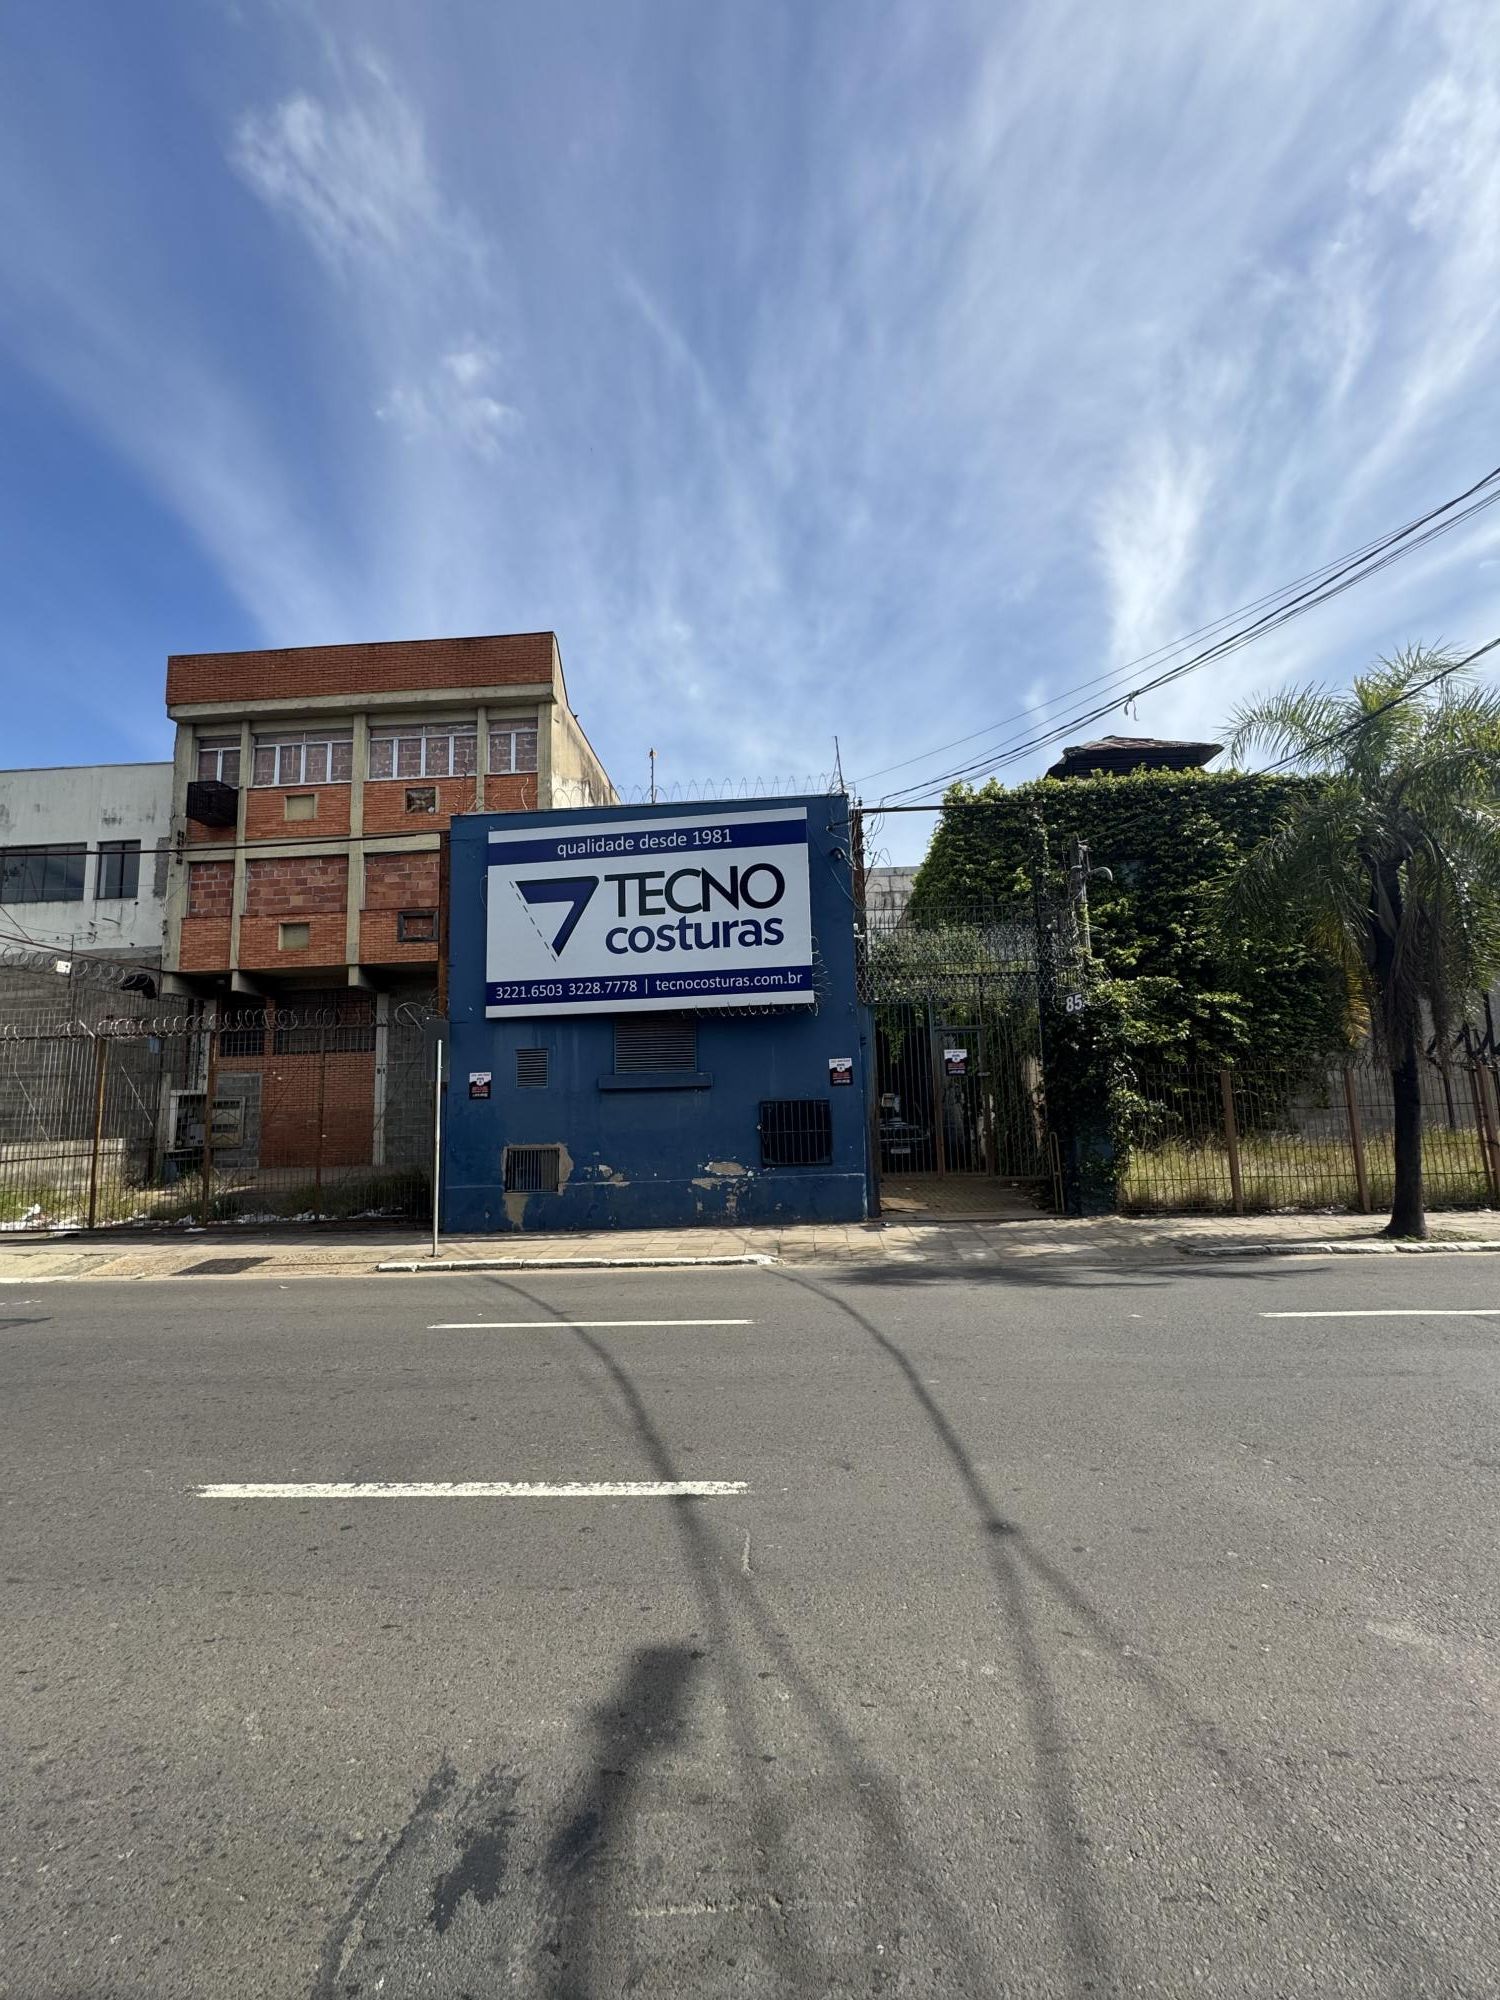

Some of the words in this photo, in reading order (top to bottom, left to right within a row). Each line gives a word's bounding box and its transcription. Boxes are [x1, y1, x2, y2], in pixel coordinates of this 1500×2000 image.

[557, 836, 635, 858] qualidade
[639, 832, 687, 849] desde
[692, 828, 732, 845] 1981
[604, 863, 786, 917] TECNO
[605, 915, 785, 954] costuras
[495, 984, 563, 999] 3221.6503
[568, 980, 638, 996] 3228.7778
[655, 971, 803, 991] tecnocosturas.com.br
[1065, 994, 1083, 1012] 85
